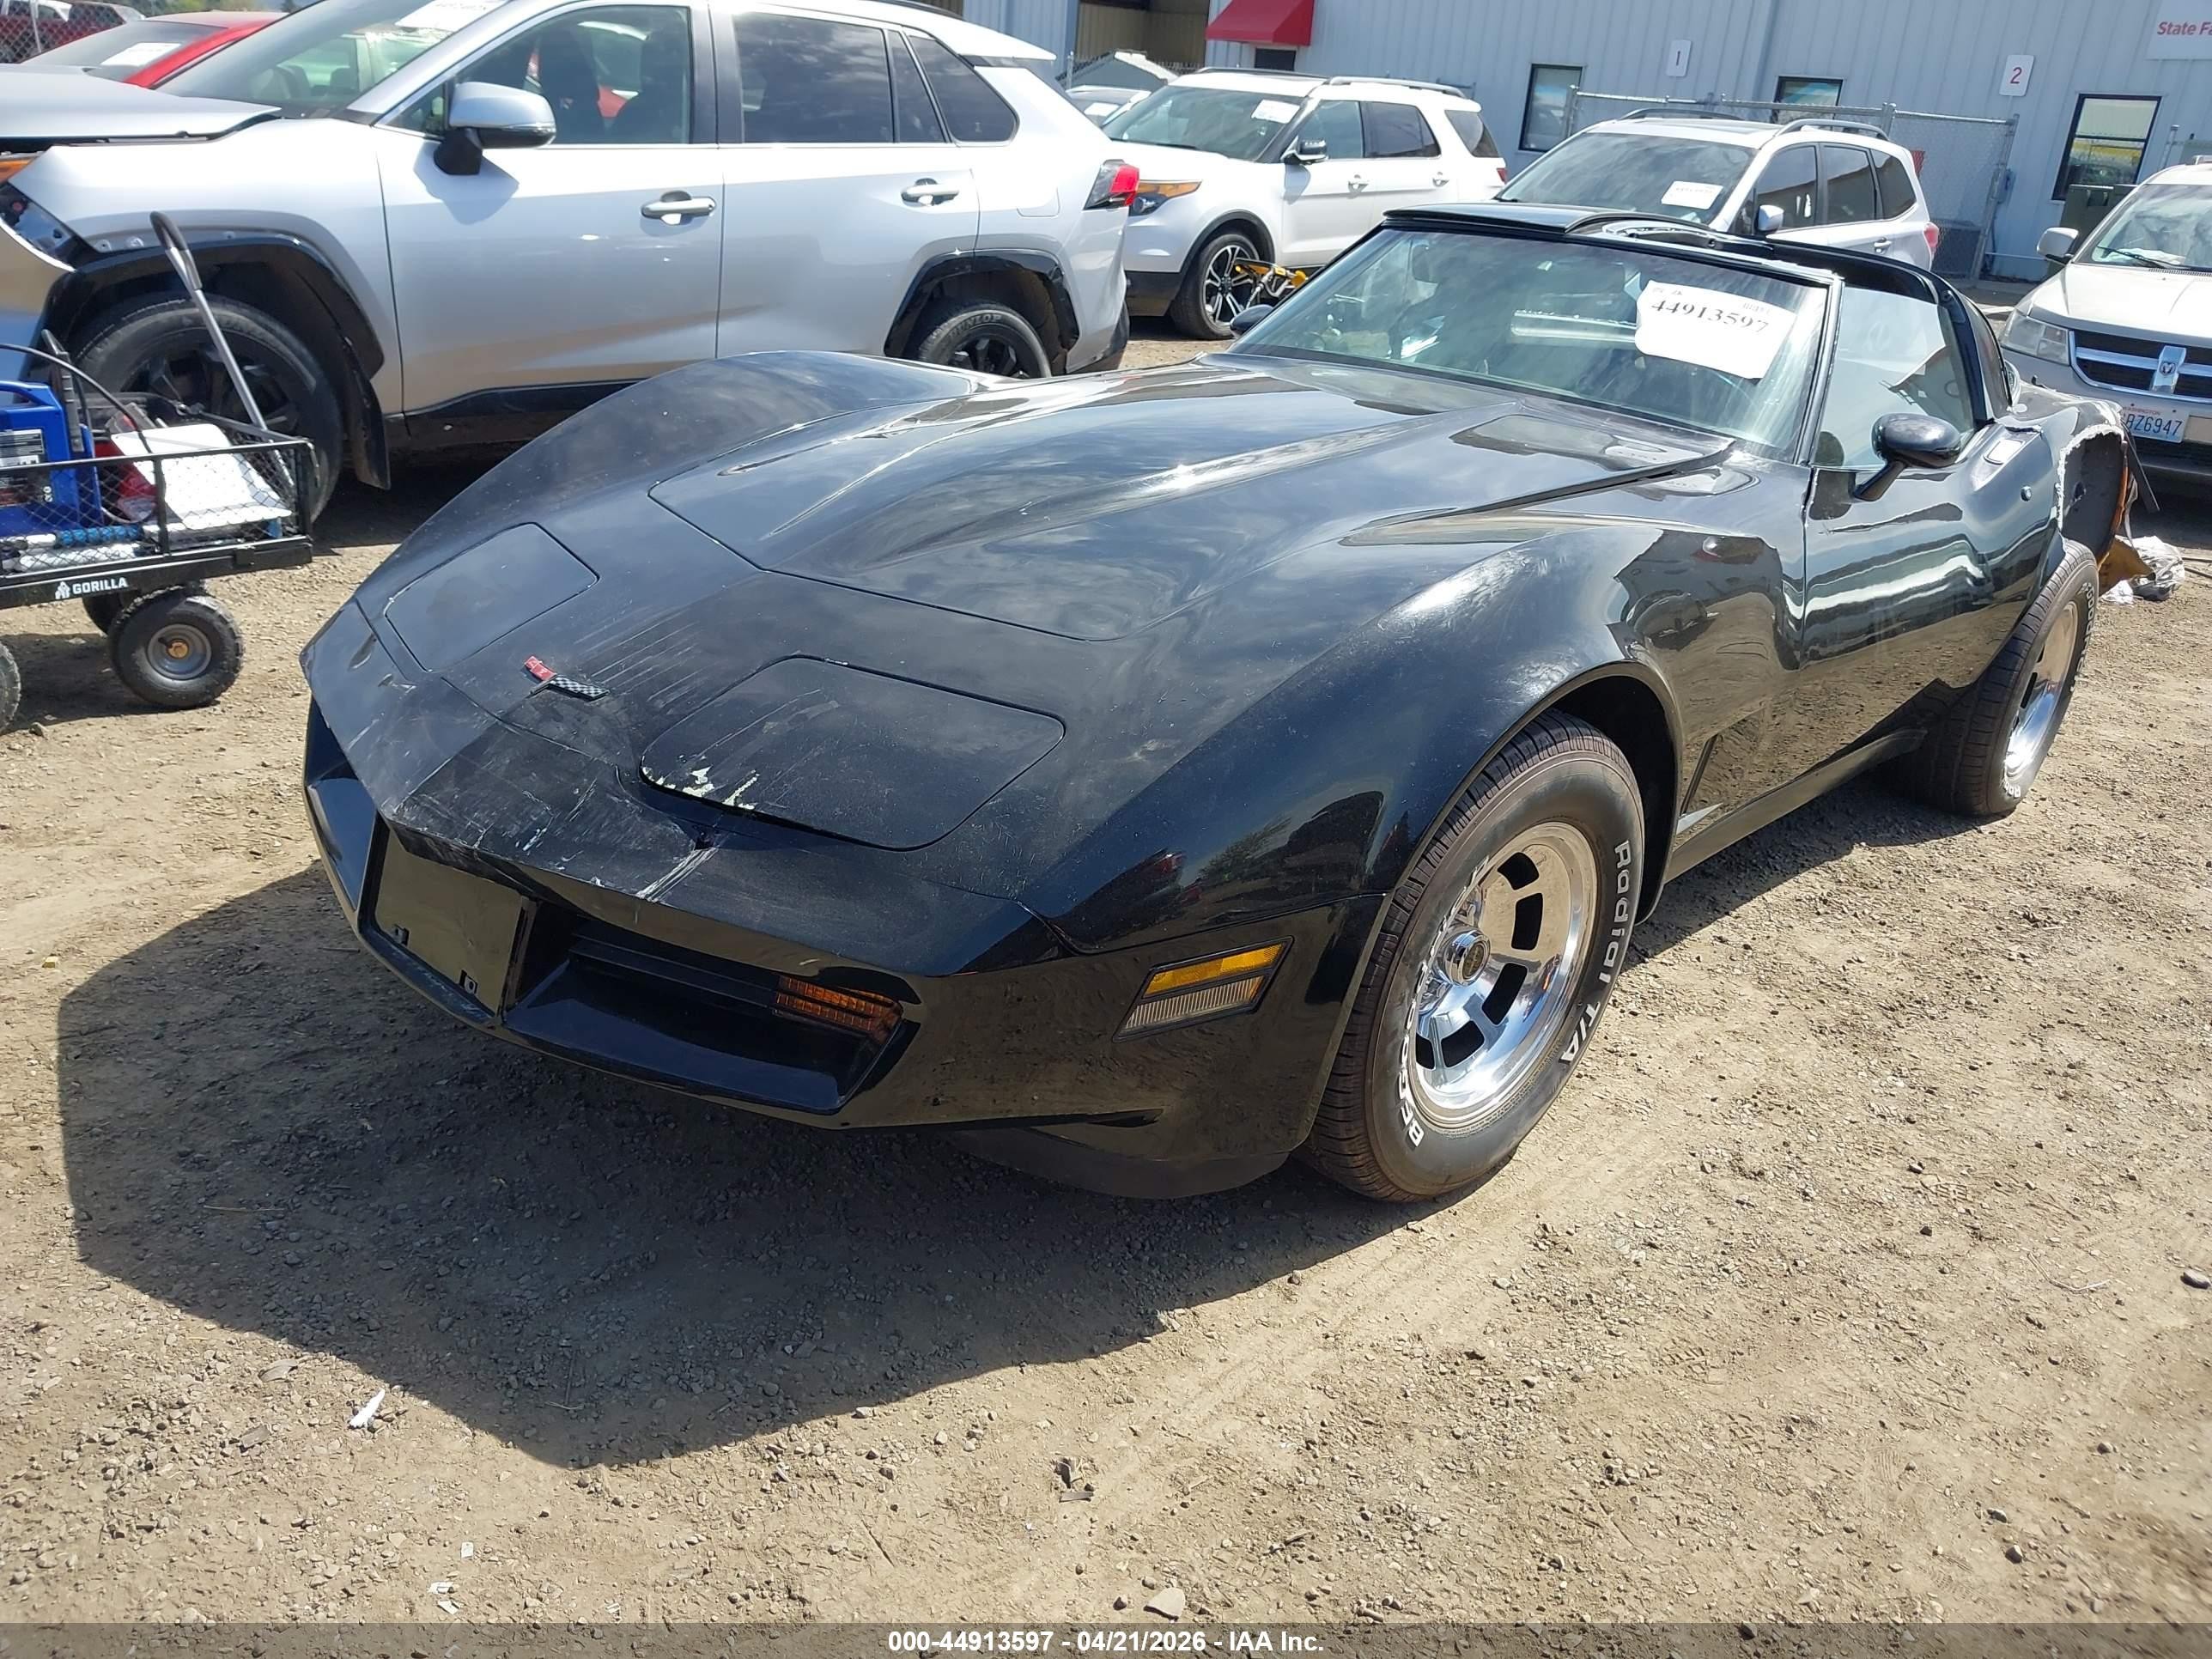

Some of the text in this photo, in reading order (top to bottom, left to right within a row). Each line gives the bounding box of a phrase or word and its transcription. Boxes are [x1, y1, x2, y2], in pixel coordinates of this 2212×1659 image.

[2157, 21, 2197, 35] State
[2010, 67, 2022, 84] 2
[1651, 299, 1769, 333] 44913597
[2124, 412, 2183, 436] BZ6947
[72, 577, 128, 594] GORILLA
[1561, 840, 1632, 1062] Radial T/A
